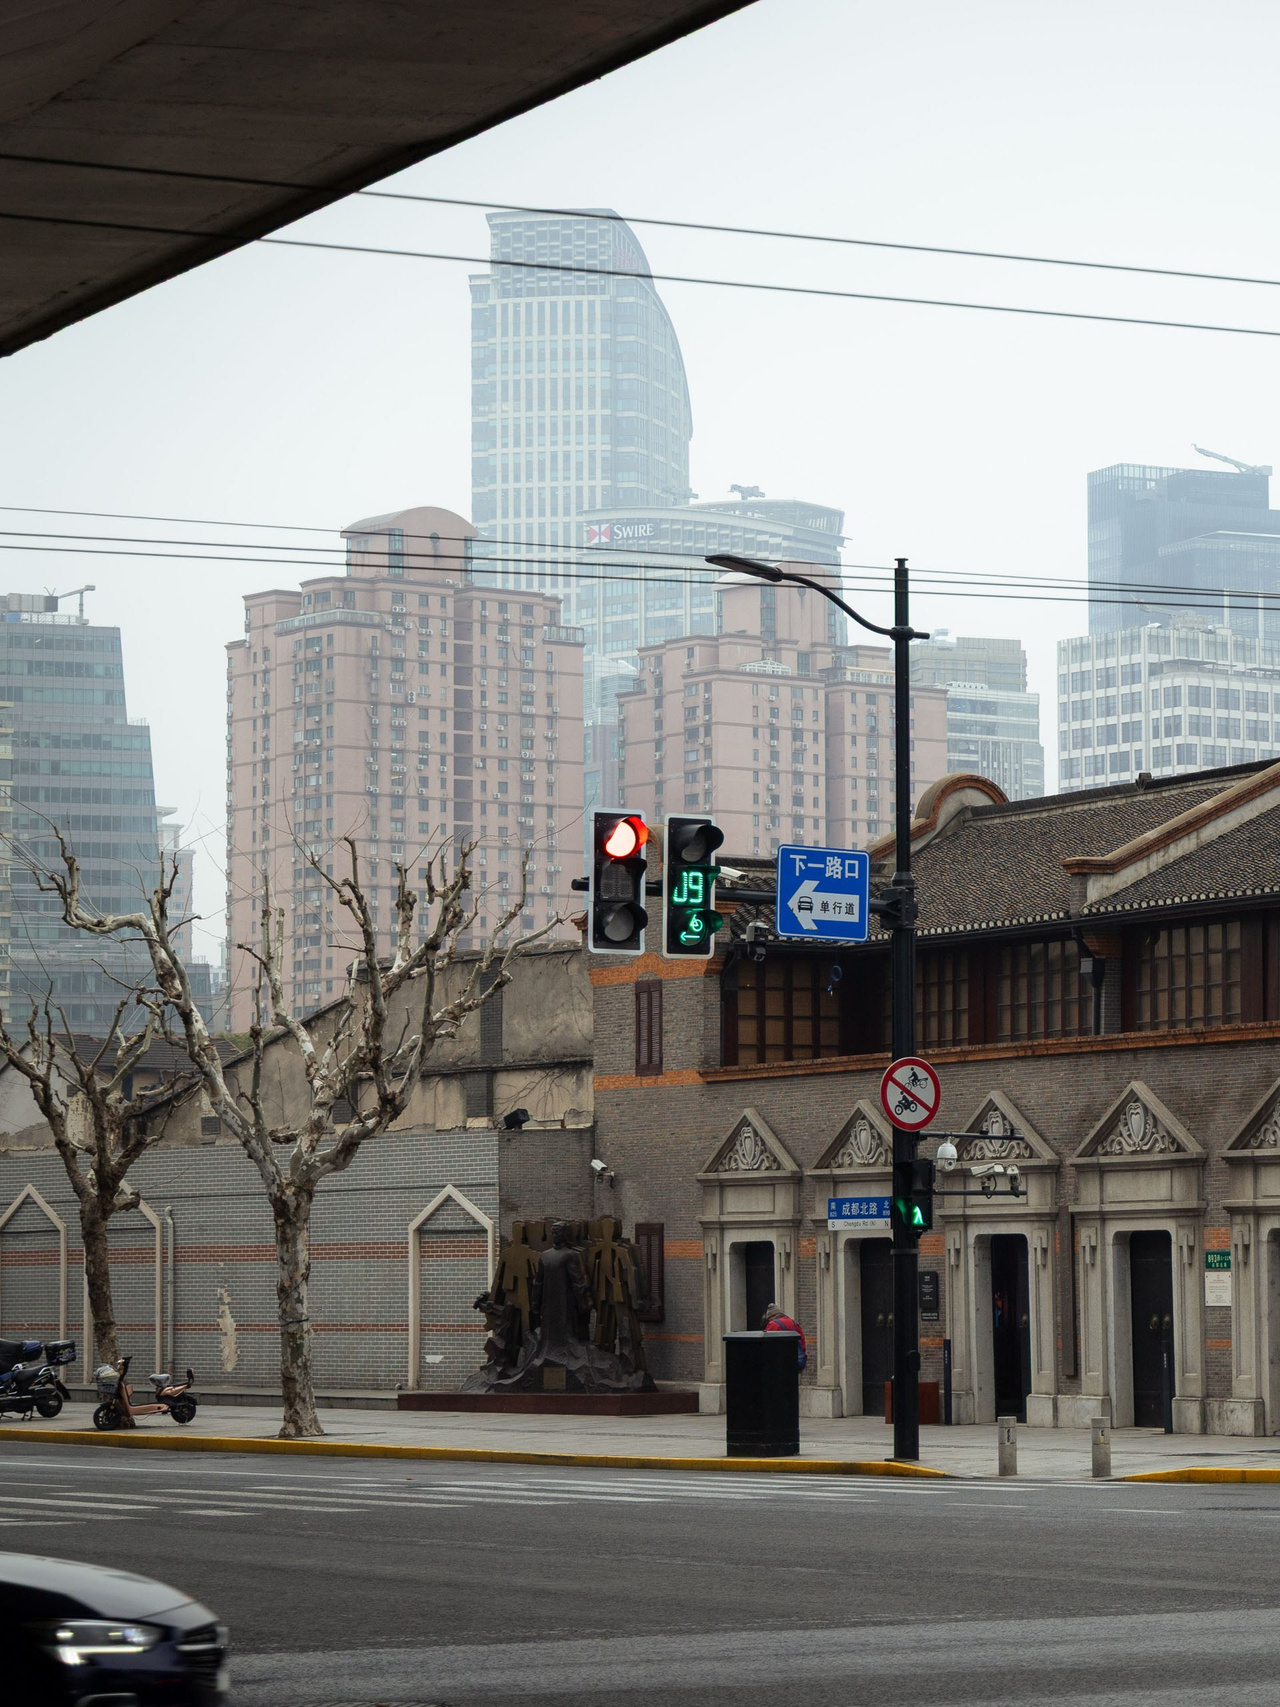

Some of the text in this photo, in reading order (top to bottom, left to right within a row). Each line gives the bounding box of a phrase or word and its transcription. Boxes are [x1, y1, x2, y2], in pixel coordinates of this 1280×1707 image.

[613, 523, 654, 540] SWIRE
[789, 854, 859, 879] 下一路口
[820, 900, 855, 915] 单行道
[842, 1202, 877, 1215] 成都北路
